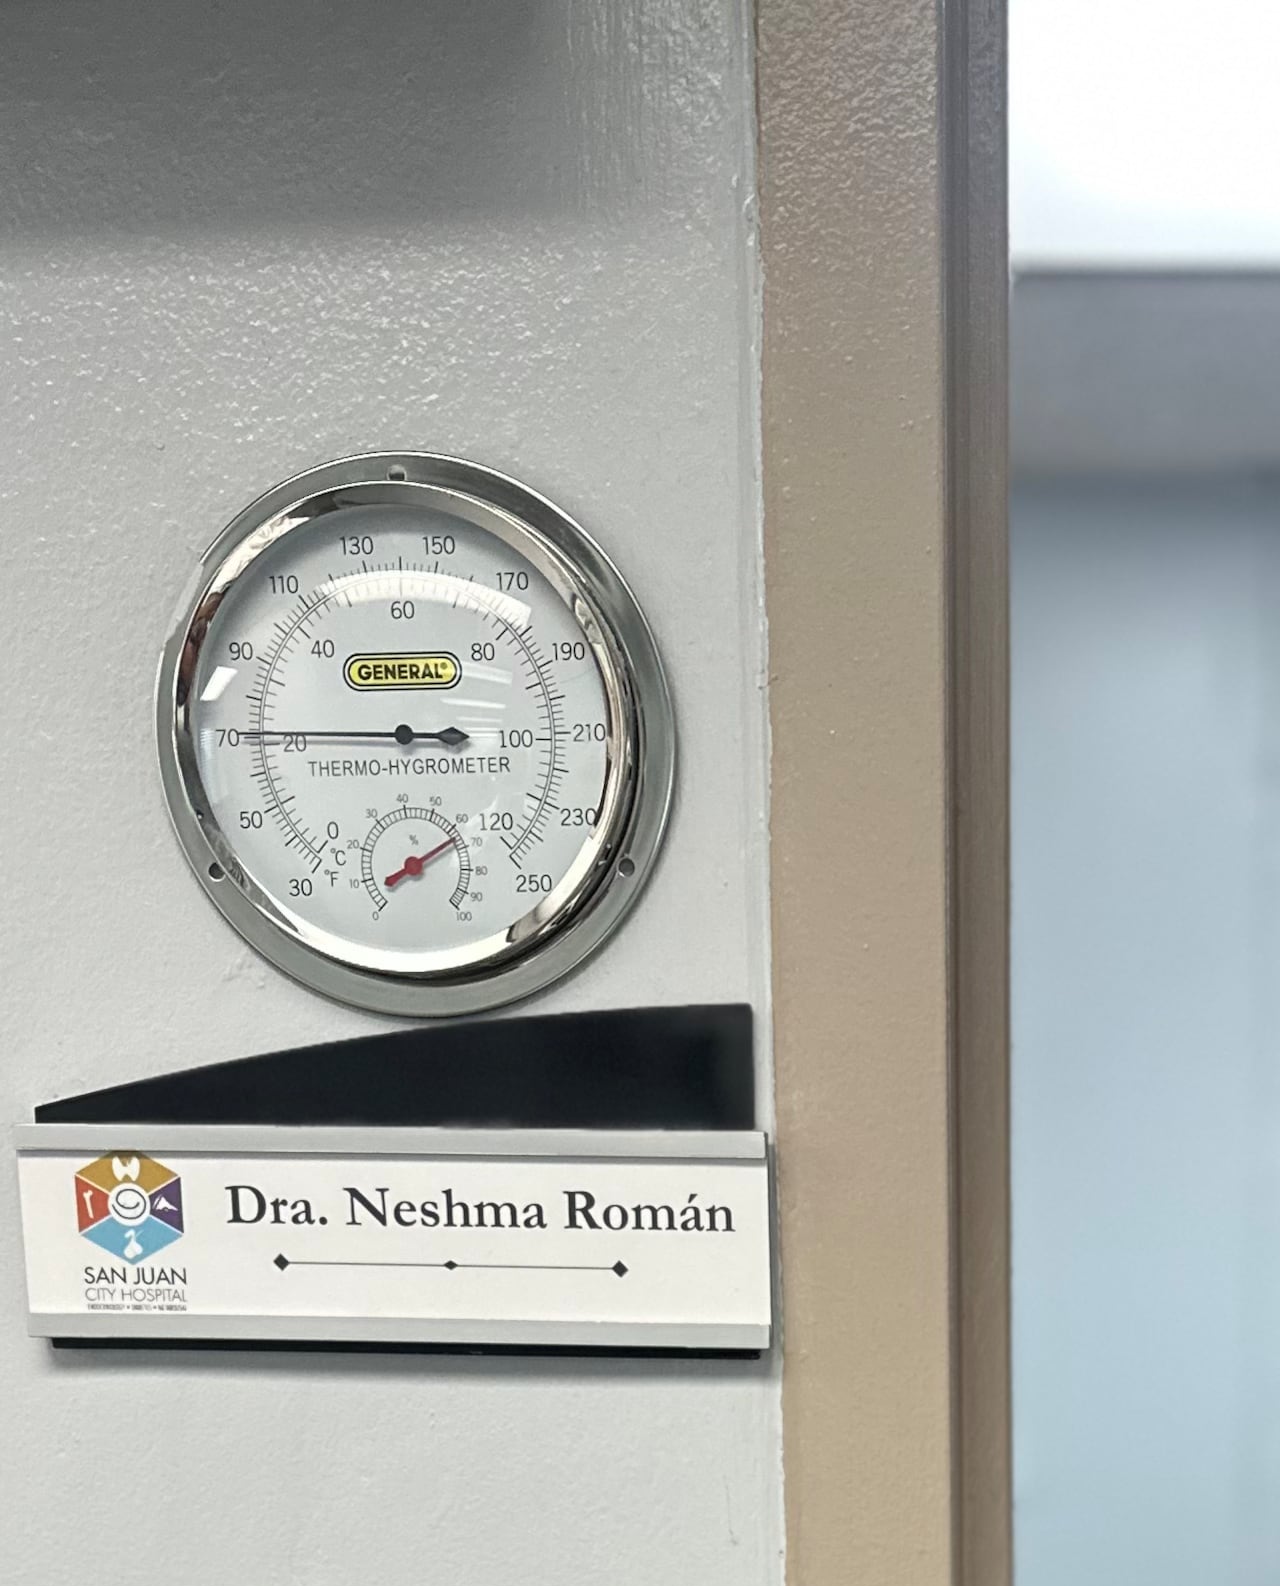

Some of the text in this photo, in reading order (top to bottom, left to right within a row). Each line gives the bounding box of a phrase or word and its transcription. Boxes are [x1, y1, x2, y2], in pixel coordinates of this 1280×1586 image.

[339, 536, 374, 555] 130
[422, 535, 456, 555] 150
[268, 575, 299, 594] 110
[495, 571, 529, 591] 170
[391, 601, 415, 619] 60
[229, 641, 253, 660] 90
[311, 640, 335, 658] 40
[471, 642, 495, 661] 80
[552, 642, 585, 661] 190
[215, 729, 240, 747] 70
[499, 729, 533, 748] 100
[572, 723, 606, 742] 210
[283, 733, 307, 752] 20
[308, 757, 510, 777] THERMO-HYGROMETER
[396, 793, 408, 803] 40
[429, 796, 442, 806] 50
[240, 811, 263, 829] 50
[366, 808, 378, 818] 30
[456, 813, 469, 823] 60
[480, 812, 513, 831] 120
[560, 808, 596, 826] 230
[327, 821, 339, 839] 0
[347, 839, 360, 849] 20
[471, 836, 483, 847] 70
[475, 866, 488, 876] 80
[289, 878, 313, 897] 30
[350, 878, 360, 889] 10
[516, 874, 552, 893] 250
[470, 892, 483, 902] 90
[456, 911, 472, 921] 100
[225, 1185, 736, 1232] Dra. Neshma Román
[84, 1266, 188, 1285] SAN JUAN
[85, 1287, 188, 1302] CITY HOSPITAL
